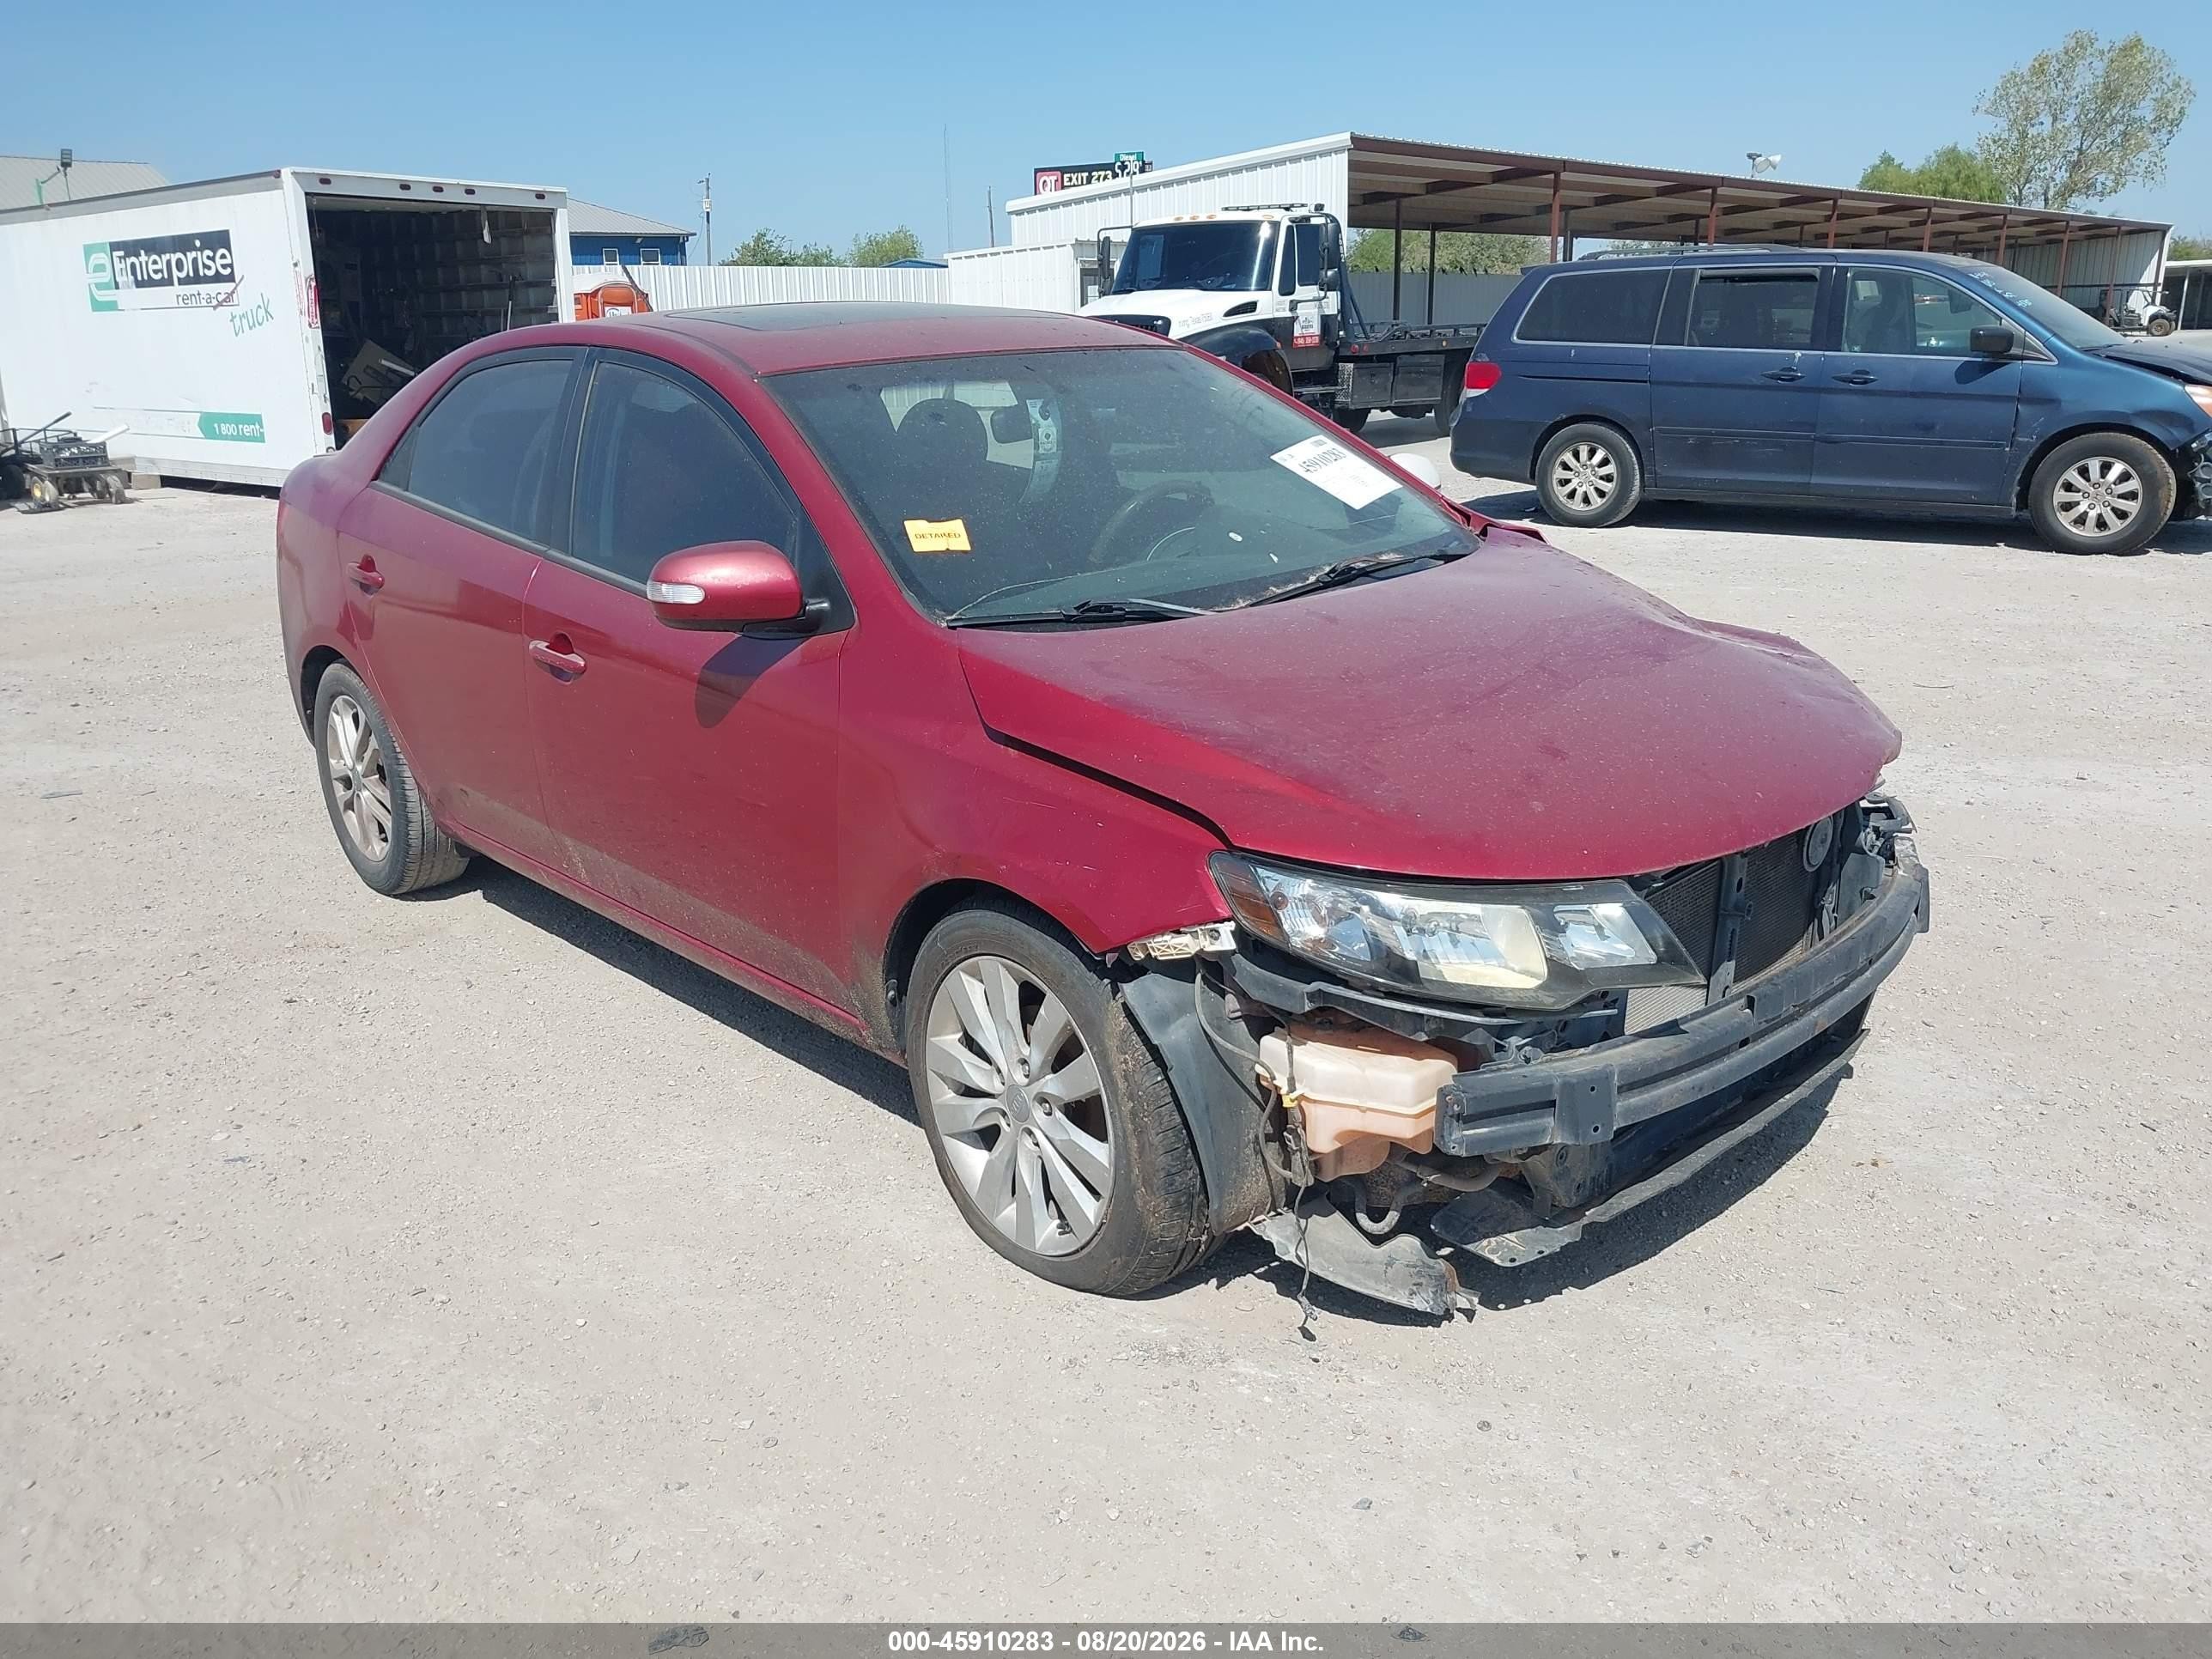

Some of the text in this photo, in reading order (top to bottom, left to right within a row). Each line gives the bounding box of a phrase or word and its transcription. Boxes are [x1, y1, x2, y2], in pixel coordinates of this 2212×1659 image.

[1039, 171, 1113, 194] QT EXIT 273
[112, 240, 233, 287] Enterprise
[175, 289, 236, 306] rent-a-car
[228, 292, 275, 337] truck
[221, 422, 237, 436] 800
[1297, 447, 1347, 474] 45910283
